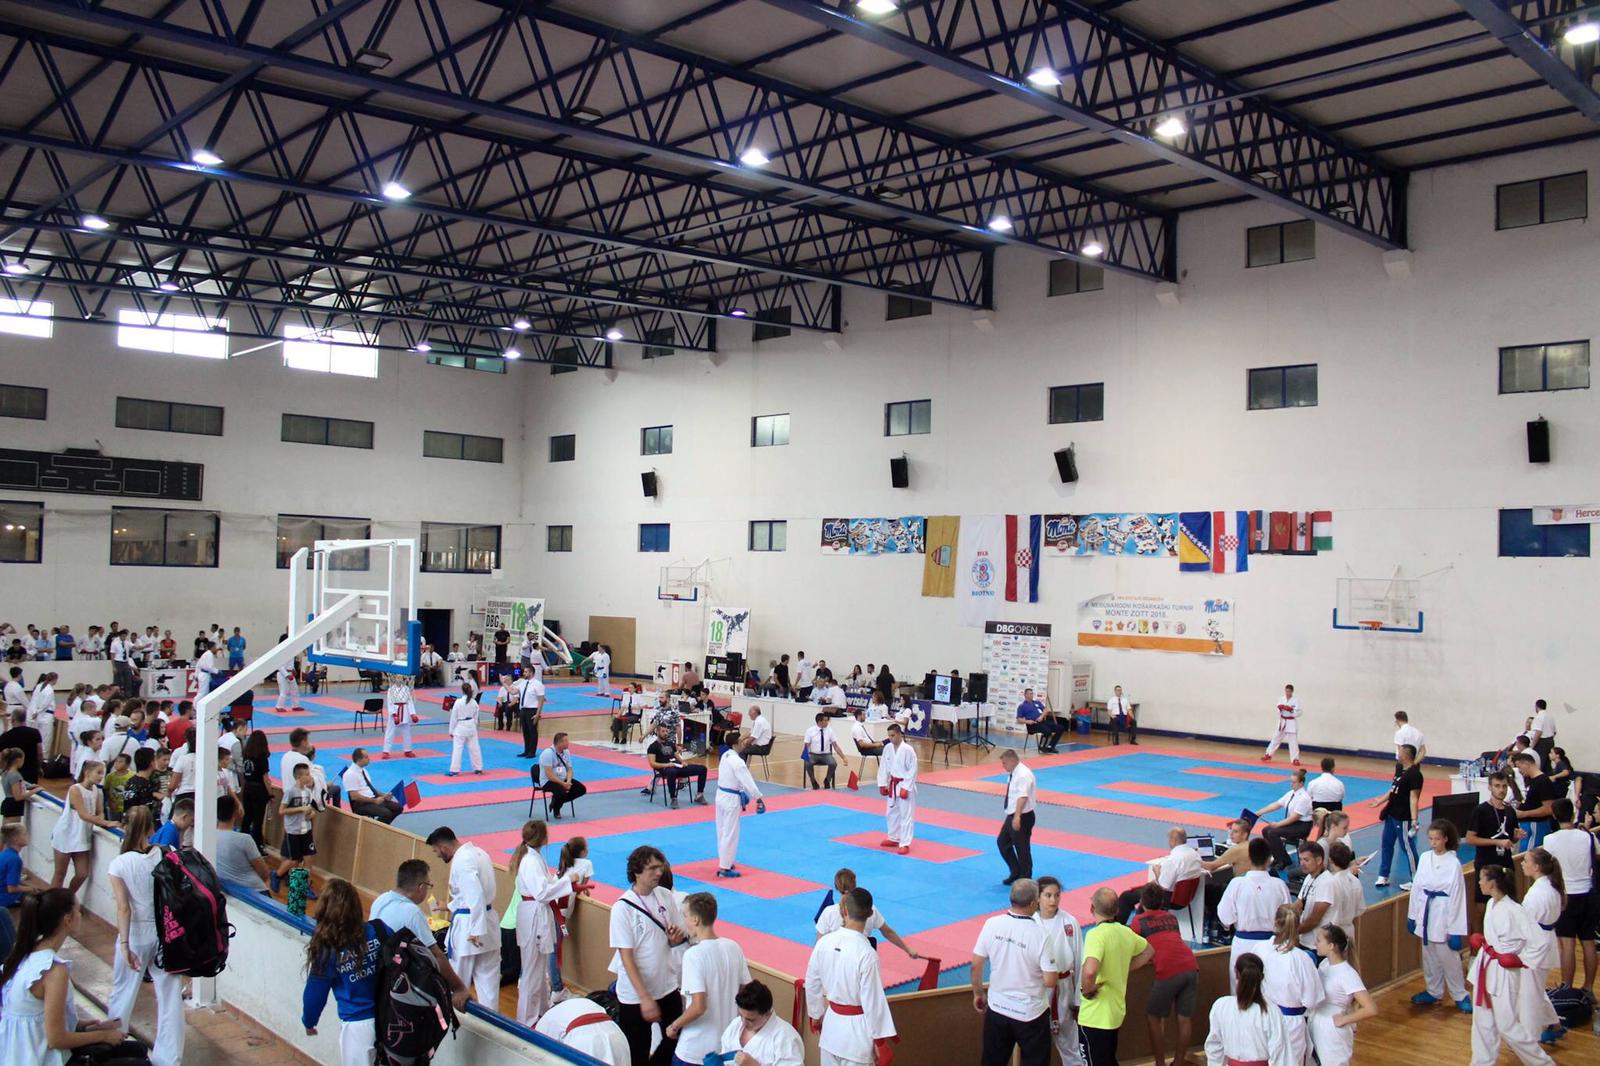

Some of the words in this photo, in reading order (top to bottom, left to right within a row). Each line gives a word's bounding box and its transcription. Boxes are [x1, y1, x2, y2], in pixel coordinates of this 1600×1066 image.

[1105, 609, 1129, 617] MONTE
[1130, 610, 1149, 618] ZOTT
[486, 615, 500, 628] DBG
[479, 665, 486, 683] 1
[673, 666, 679, 684] 6
